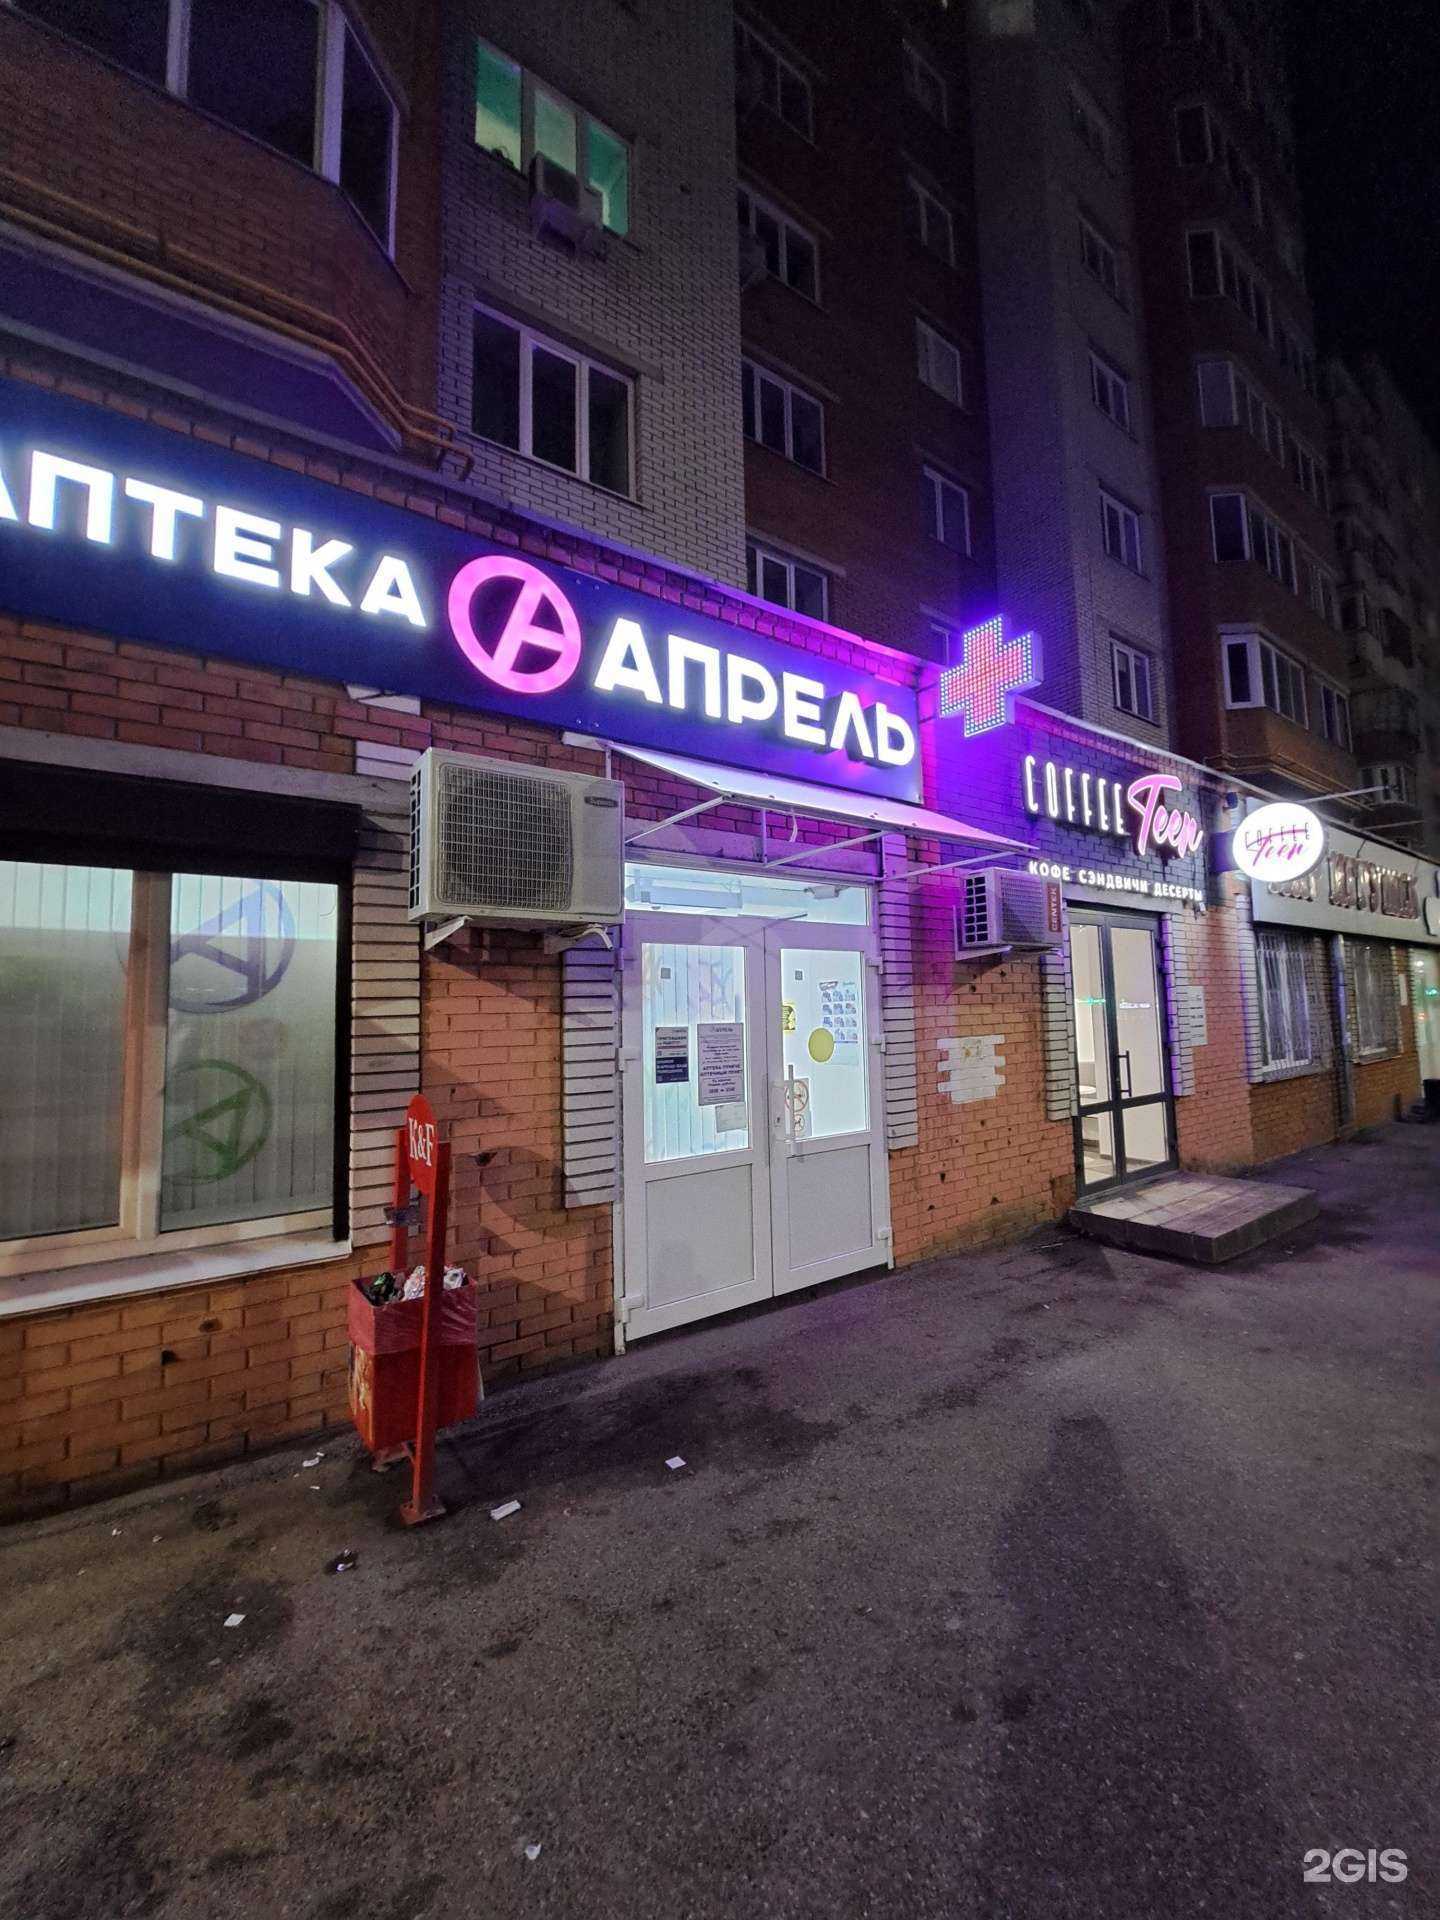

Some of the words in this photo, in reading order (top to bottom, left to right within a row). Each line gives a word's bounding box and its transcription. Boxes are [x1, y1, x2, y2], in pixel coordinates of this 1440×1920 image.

[0, 449, 428, 628] ПТЕКА
[594, 616, 916, 767] АПРЕЛЬ
[1025, 755, 1127, 835] COFFEE
[1127, 774, 1204, 859] Teen
[1029, 861, 1071, 881] КОФЕ
[1078, 869, 1149, 893] СЭНДВИЧИ
[1153, 881, 1204, 902] ДЕСЕРТЫ
[408, 1117, 435, 1167] K&F
